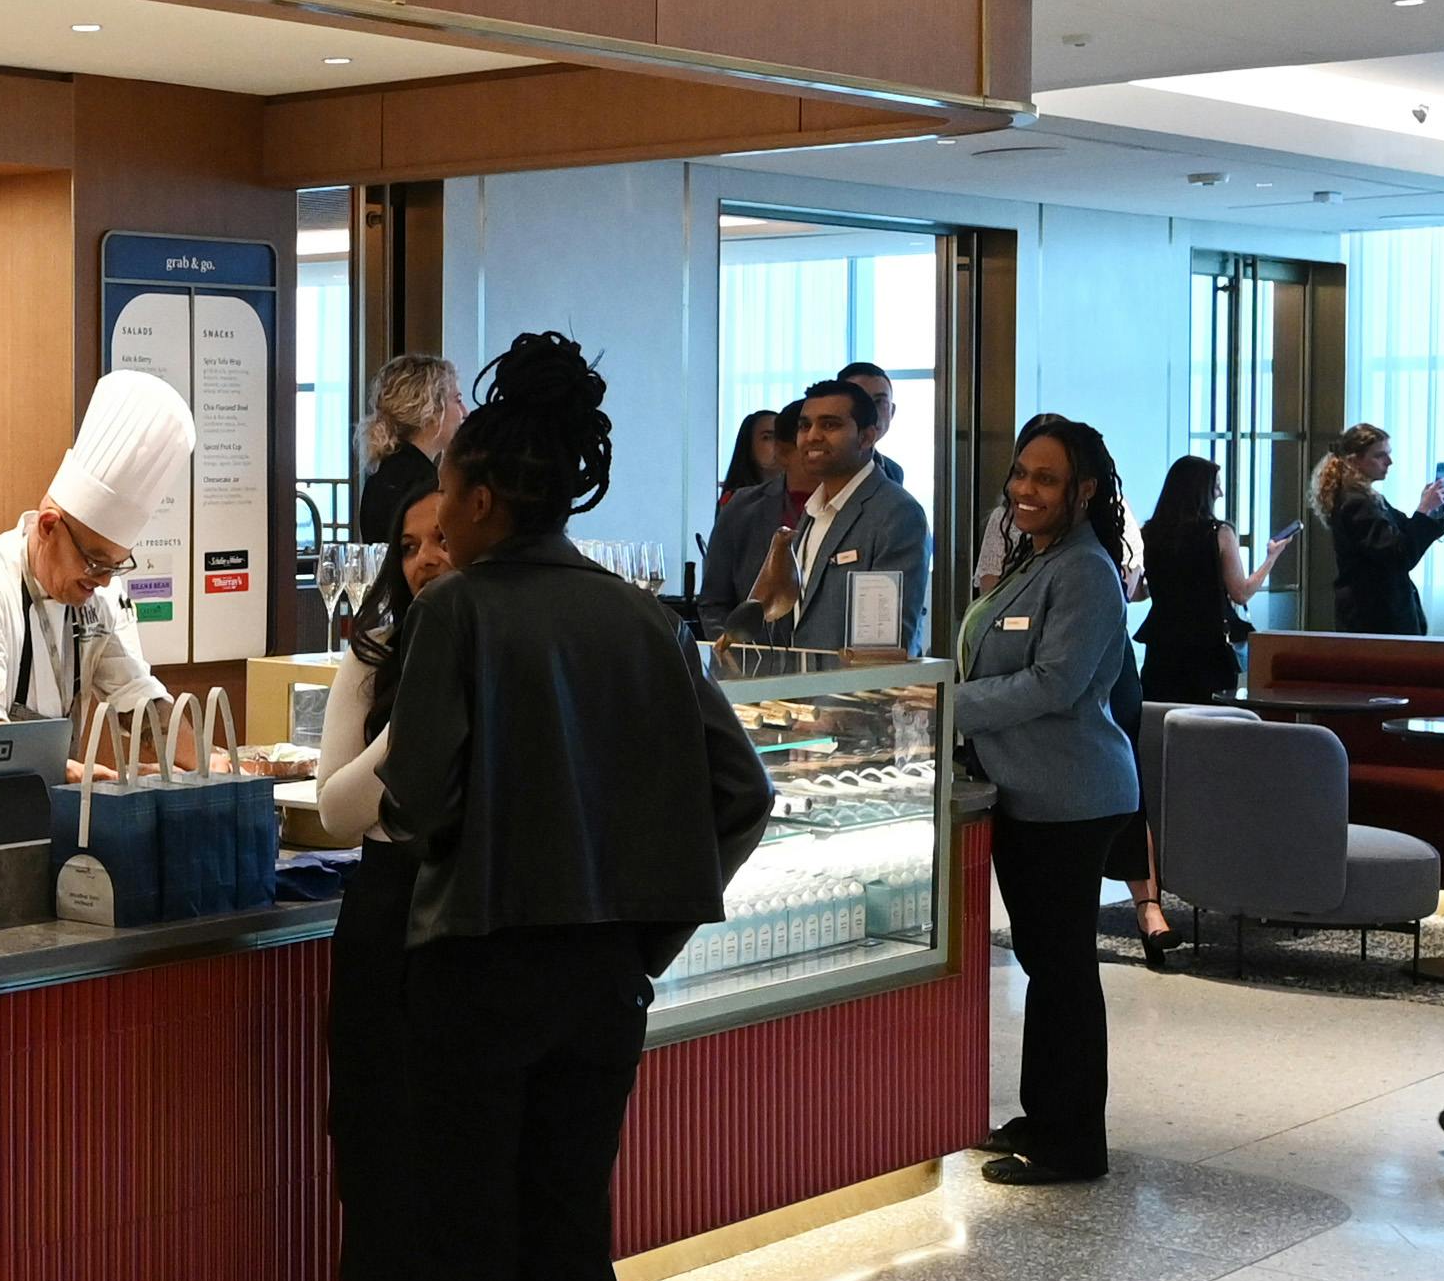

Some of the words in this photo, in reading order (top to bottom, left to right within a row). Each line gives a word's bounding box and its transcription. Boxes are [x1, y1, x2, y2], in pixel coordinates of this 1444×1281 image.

[166, 255, 190, 272] grab
[190, 257, 199, 270] &
[200, 260, 216, 273] go.
[122, 327, 153, 336] SALADS
[203, 329, 234, 339] SNACKS
[145, 539, 182, 547] PRODUCTS
